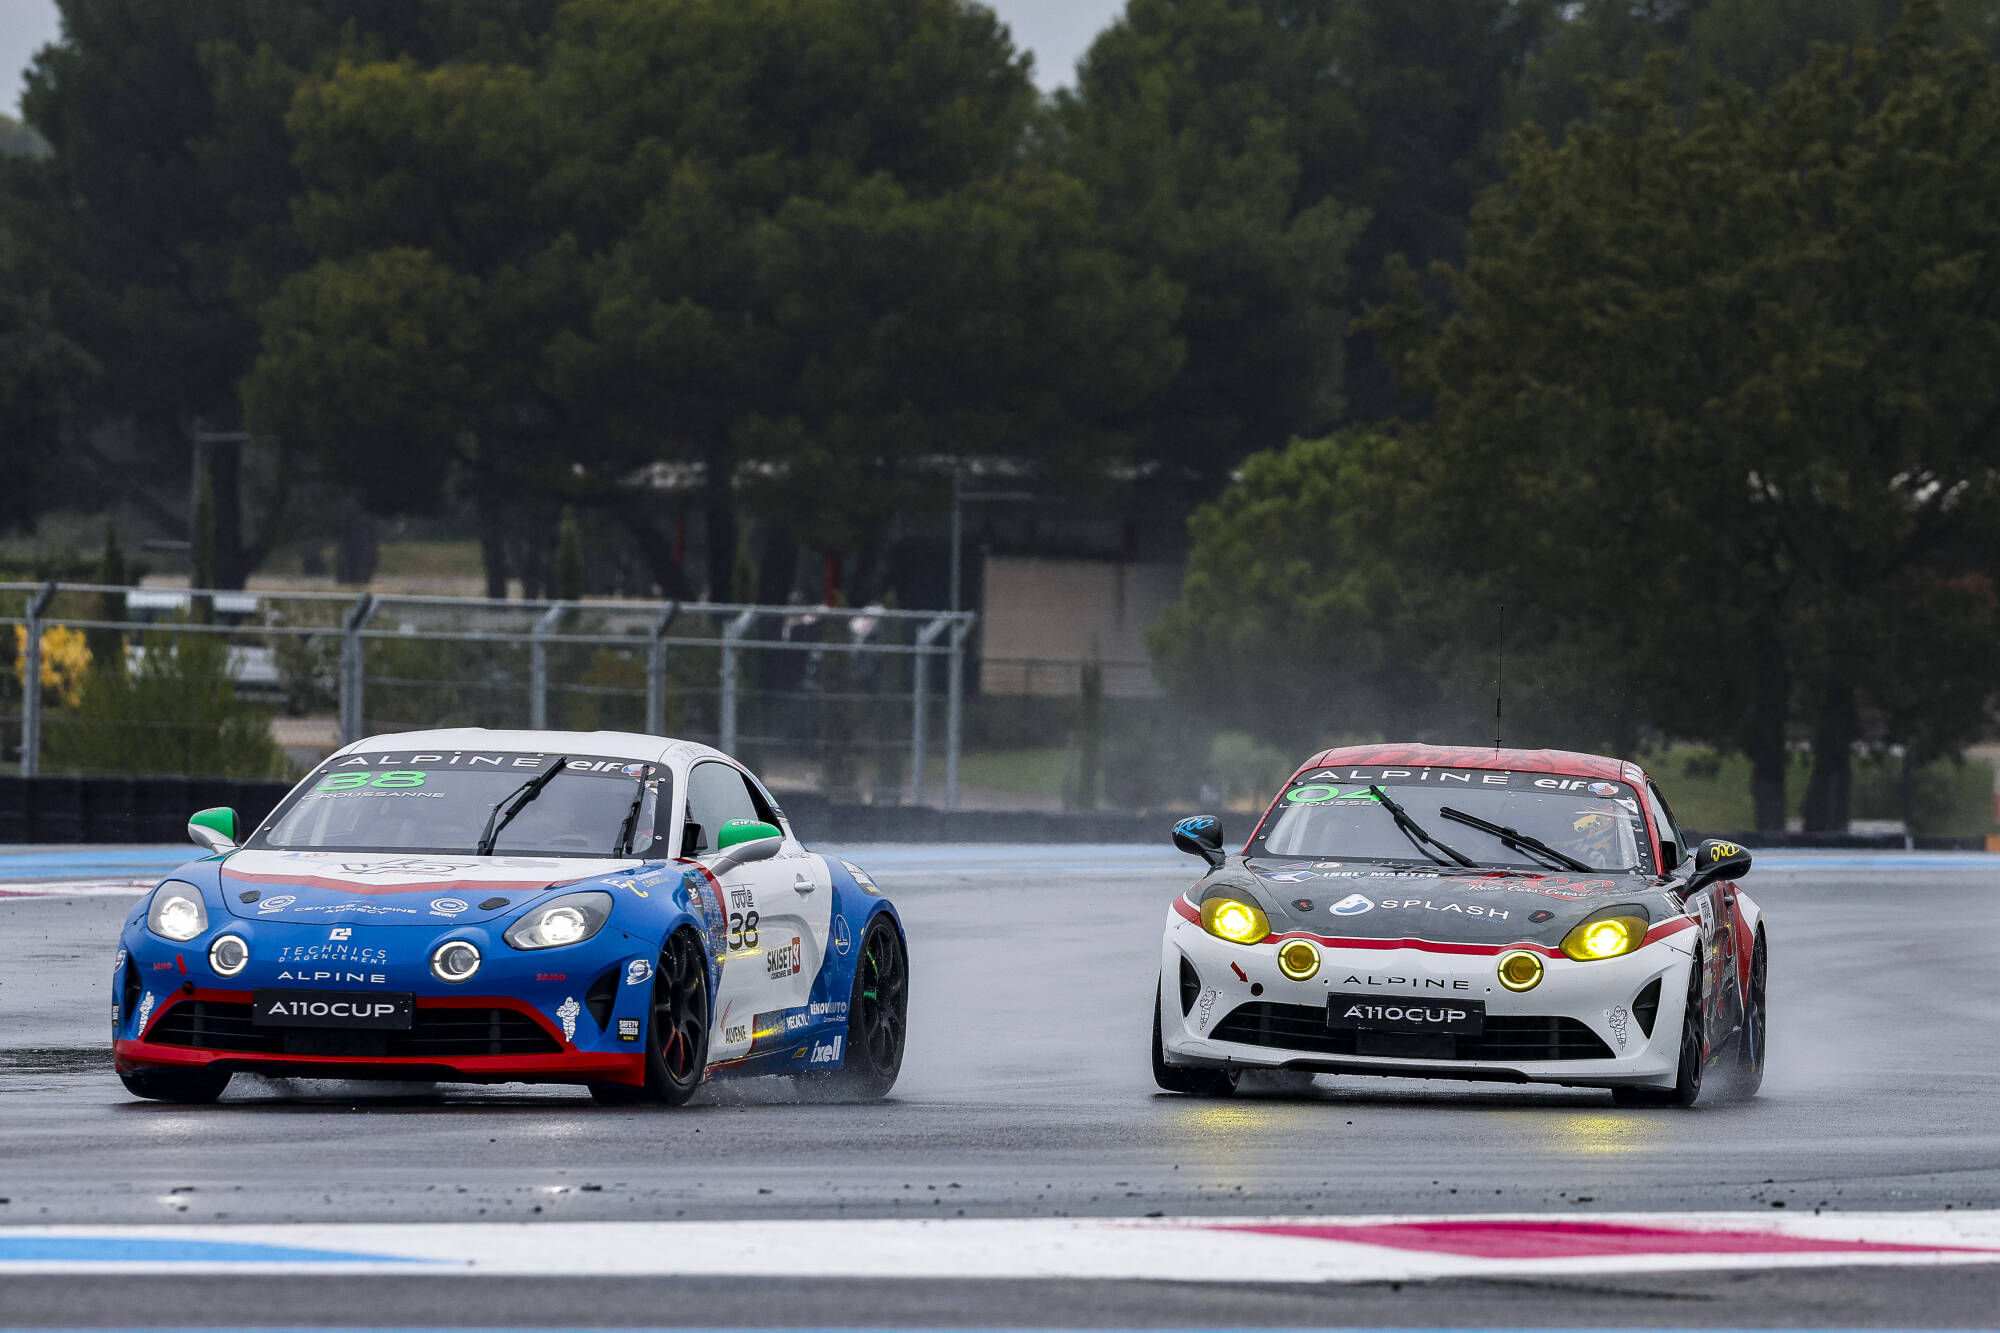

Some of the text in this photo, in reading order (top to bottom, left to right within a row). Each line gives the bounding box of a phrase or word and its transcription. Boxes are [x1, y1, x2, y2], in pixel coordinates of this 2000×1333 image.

[337, 755, 542, 768] ALPINE
[566, 759, 624, 773] elf
[316, 770, 427, 791] 38
[1309, 770, 1509, 785] ALPINE
[1534, 778, 1588, 791] elf
[1286, 785, 1392, 803] 04
[1369, 871, 1439, 879] MASTER
[294, 904, 356, 912] CENTRE
[364, 905, 418, 914] ALPINE
[323, 907, 389, 915] ANNECY
[1380, 900, 1510, 919] SPLASH
[729, 911, 759, 951] 38
[282, 944, 387, 959] TECHNICS
[767, 946, 792, 973] SKISET
[277, 971, 386, 983] ALPINE
[1343, 975, 1470, 990] ALPINE
[268, 1001, 395, 1018] A110CUP
[1343, 1005, 1467, 1023] A110CUP
[810, 1035, 842, 1063] ixell
